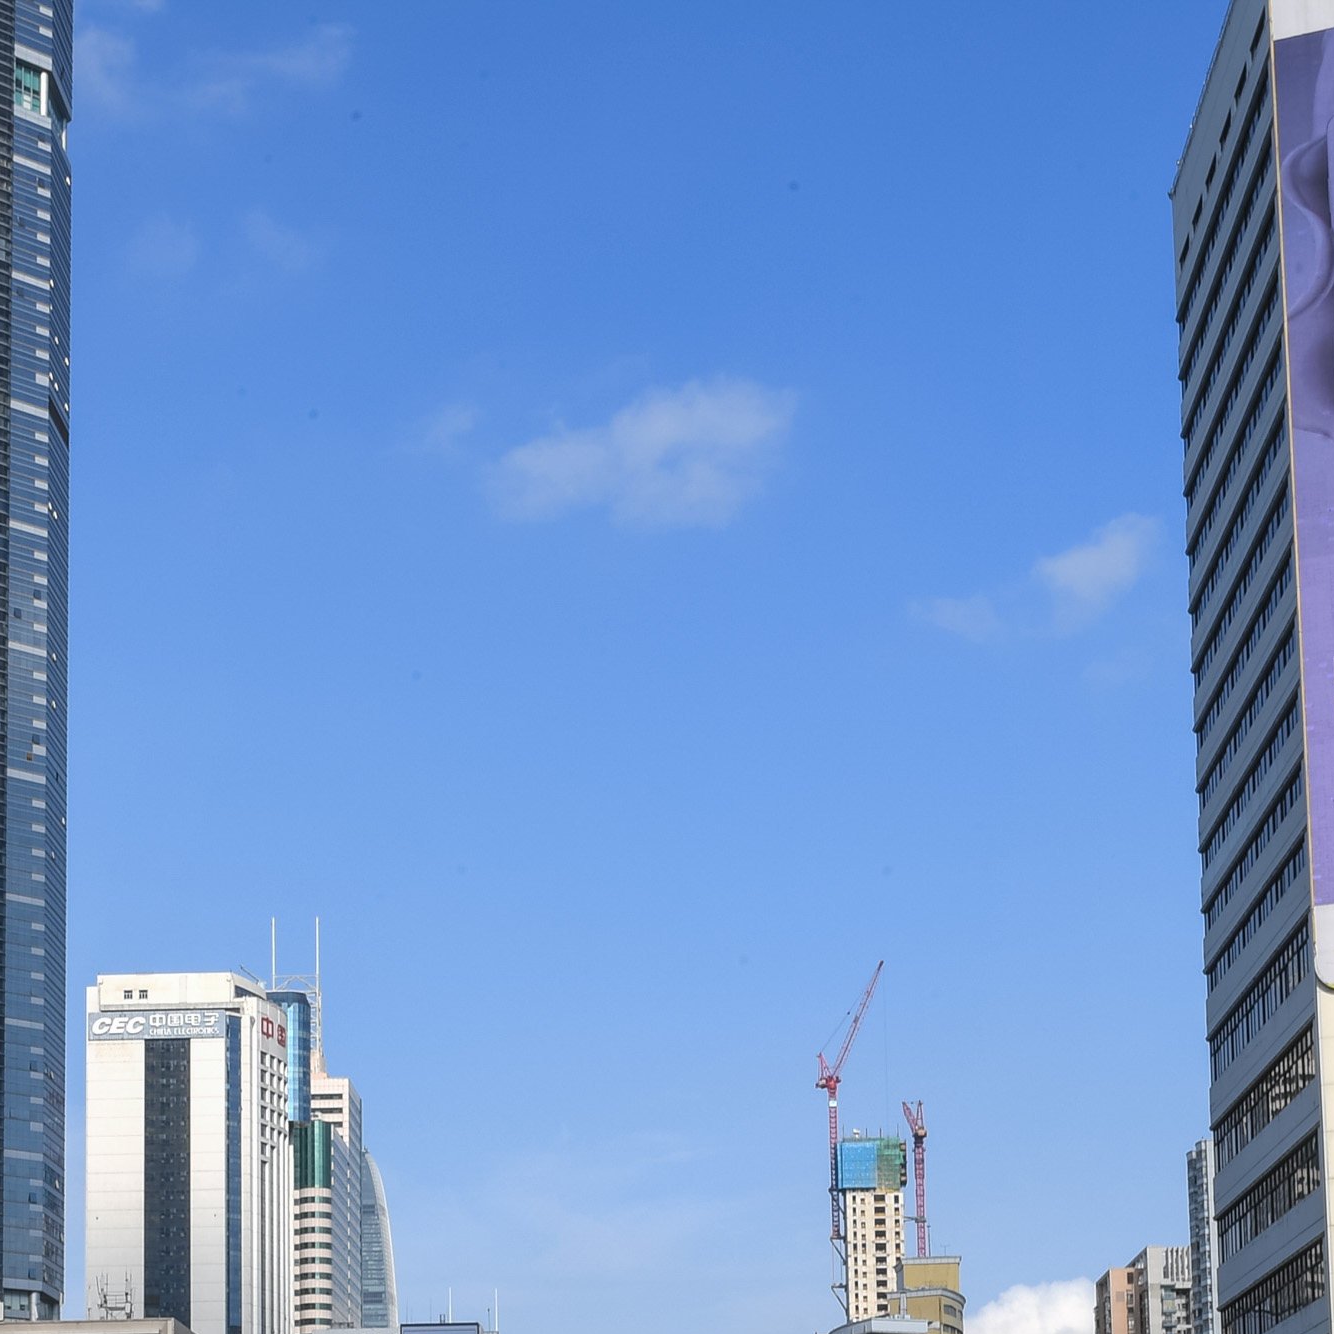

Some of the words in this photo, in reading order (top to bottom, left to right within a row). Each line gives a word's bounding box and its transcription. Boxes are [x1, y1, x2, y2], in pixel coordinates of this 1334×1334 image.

[91, 1016, 146, 1035] CEC
[149, 1012, 219, 1027] 中国电子
